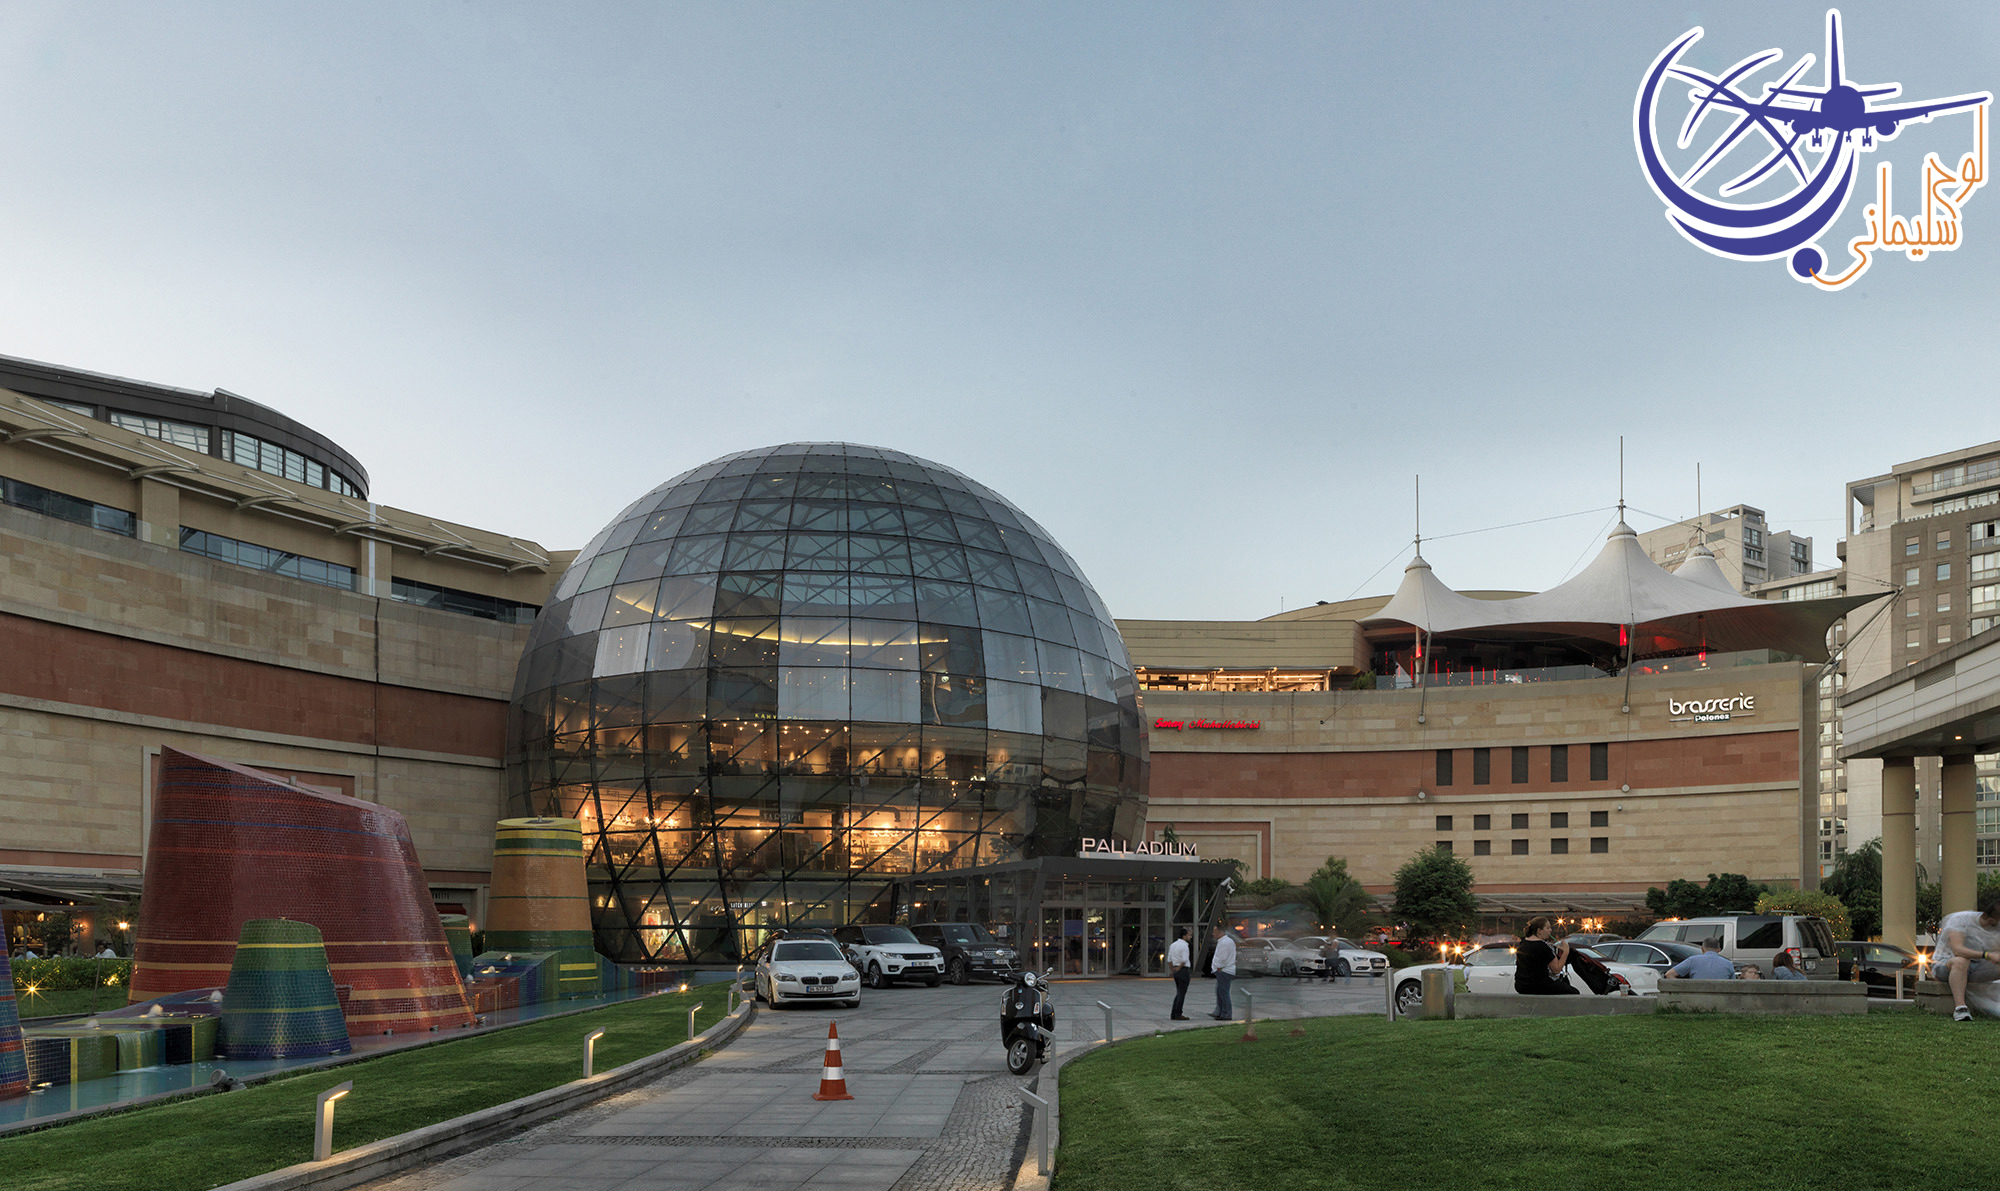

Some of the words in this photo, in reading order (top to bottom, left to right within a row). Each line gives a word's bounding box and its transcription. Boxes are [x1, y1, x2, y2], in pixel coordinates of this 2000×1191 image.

[1669, 692, 1755, 715] brasserie
[1154, 717, 1185, 731] Saray
[1082, 837, 1198, 856] PALLADIUM
